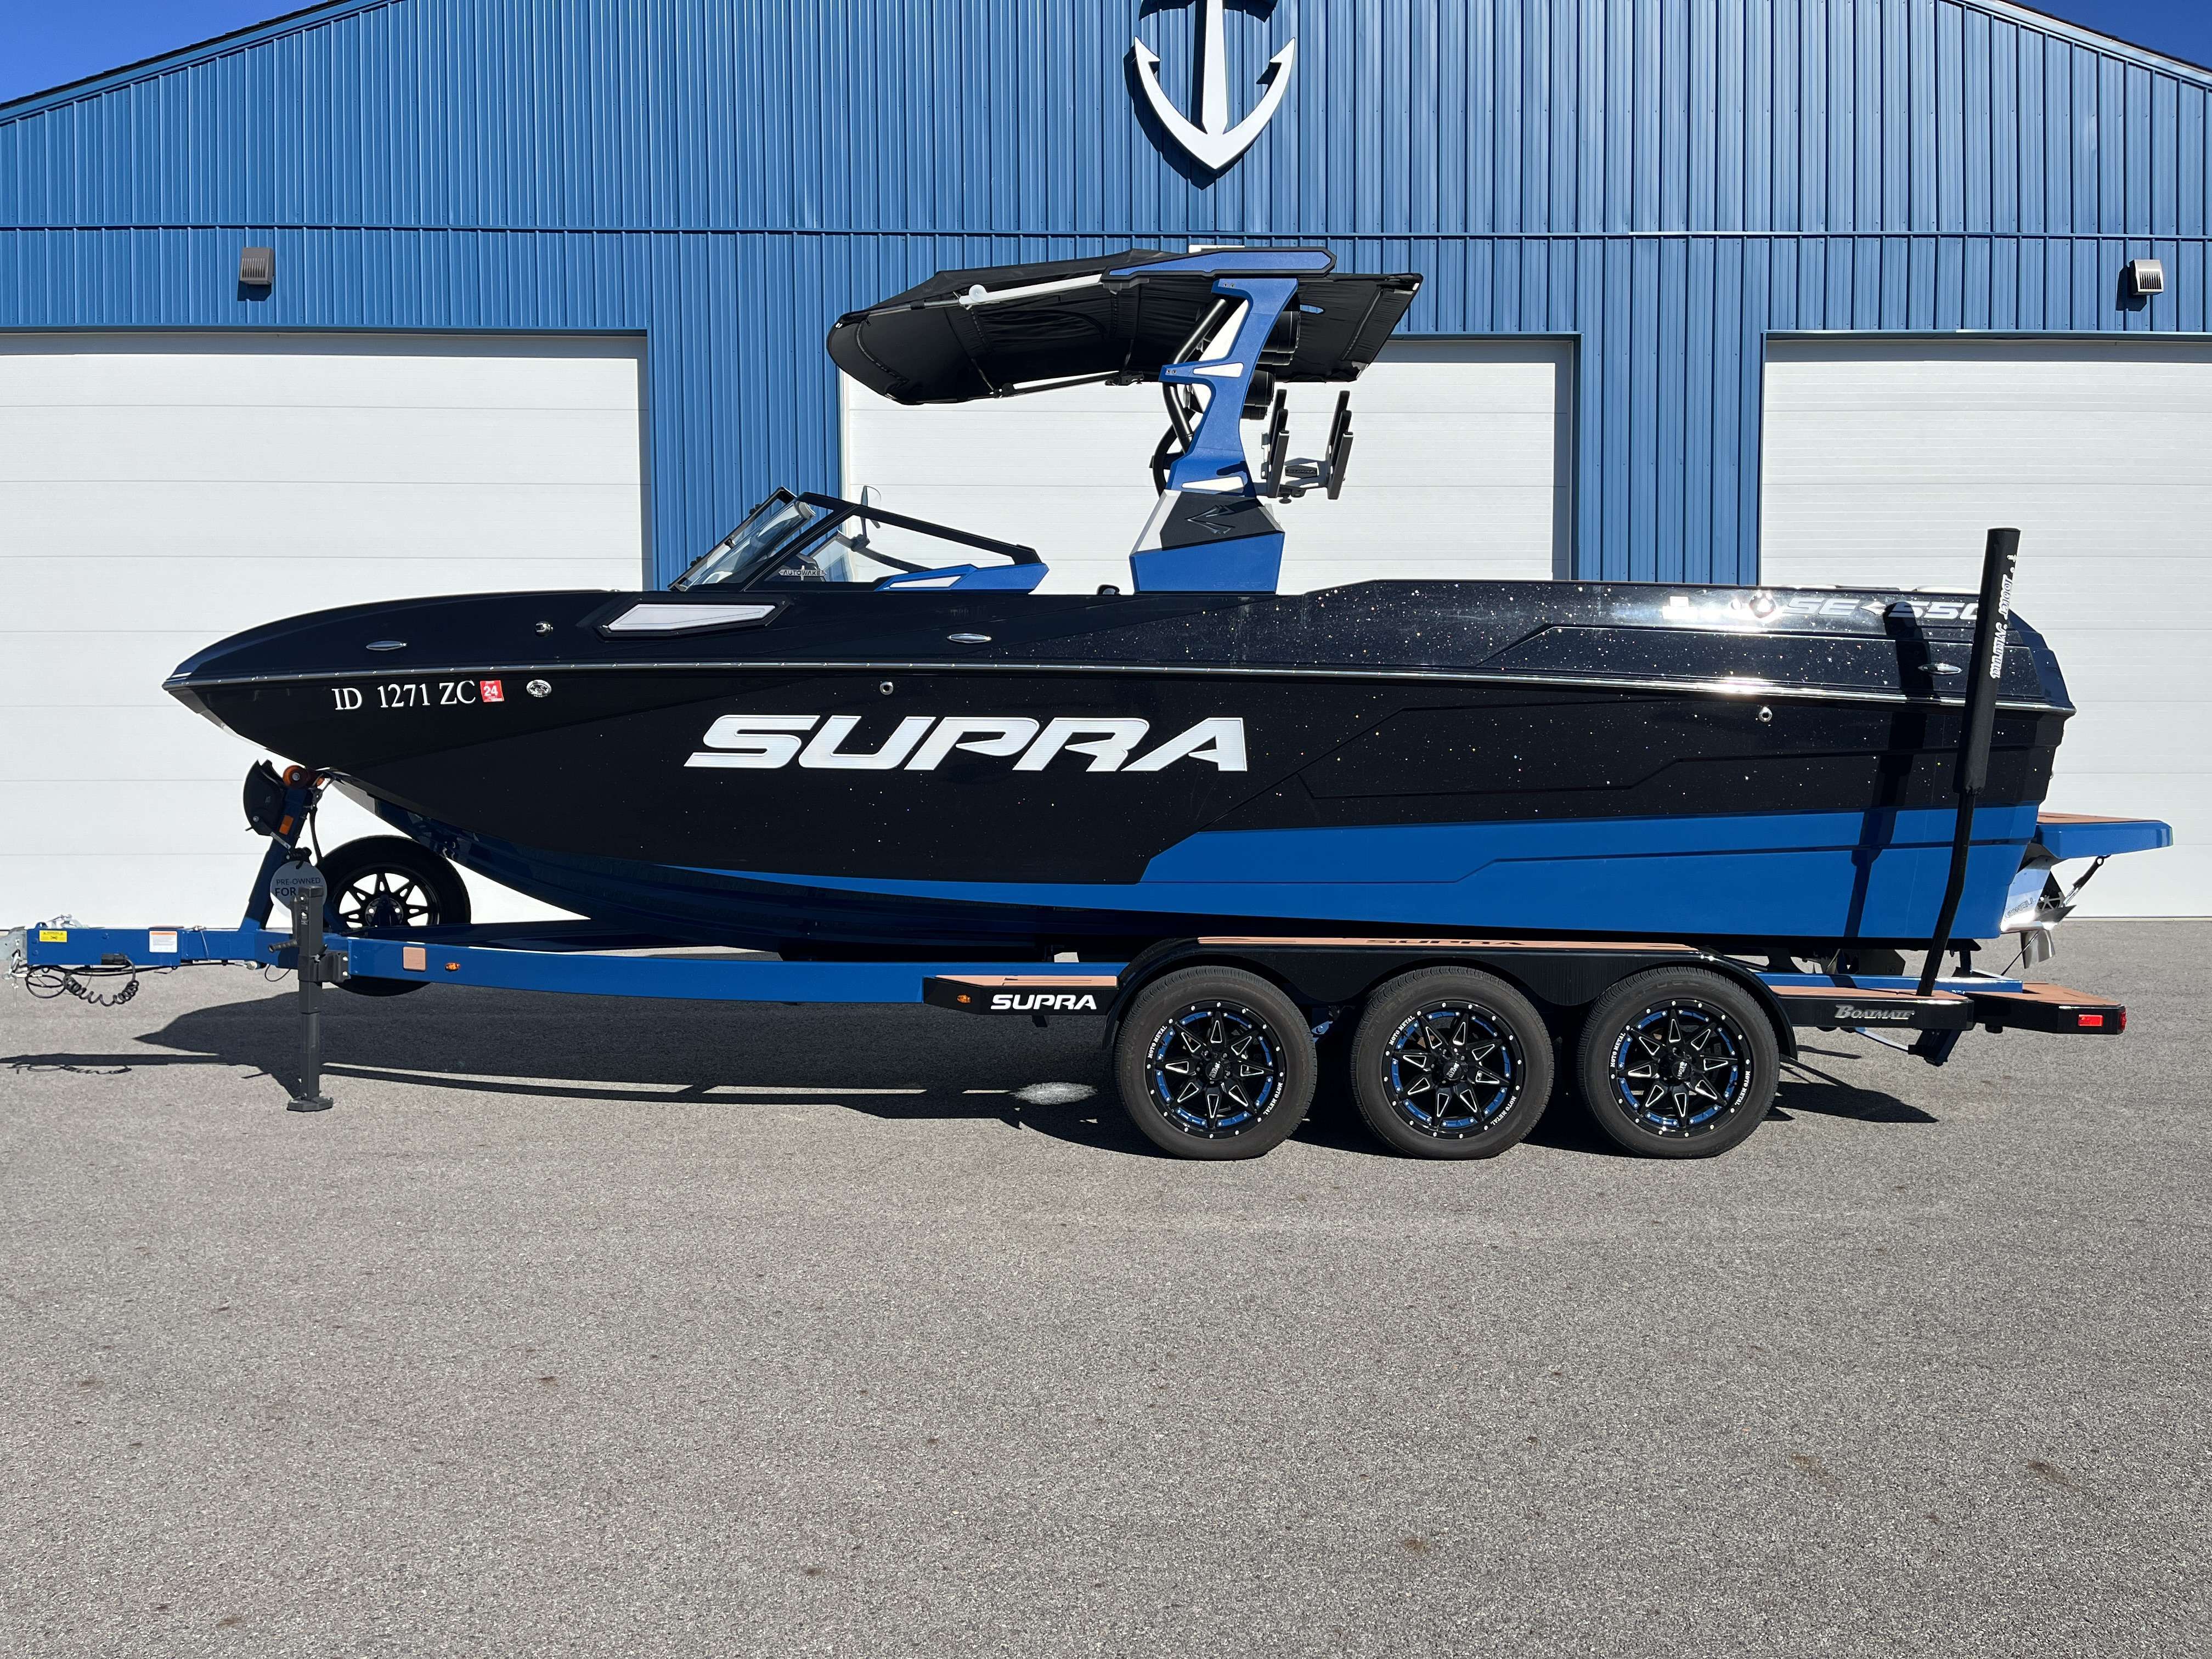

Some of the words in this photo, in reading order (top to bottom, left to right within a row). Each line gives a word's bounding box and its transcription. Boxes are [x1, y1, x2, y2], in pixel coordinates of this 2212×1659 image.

[331, 687, 362, 710] ID
[377, 684, 431, 708] 1271
[439, 679, 476, 705] ZC
[484, 685, 498, 696] 24
[684, 715, 1248, 772] SUPRA
[276, 877, 321, 885] PRE-OWNED
[275, 887, 297, 896] FOR
[990, 994, 1097, 1010] SUPRA
[1389, 1030, 1400, 1045] MOTO
[1398, 1015, 1415, 1031] METAL
[1148, 1042, 1156, 1059] MOTO
[1153, 1025, 1167, 1042] METAL
[1613, 1032, 1626, 1051] METAL
[1274, 1082, 1283, 1098] MOTO
[1734, 1087, 1747, 1105] METAL
[1263, 1098, 1277, 1115] METAL
[1505, 1095, 1517, 1111] MOTO
[1490, 1110, 1508, 1126] METAL
